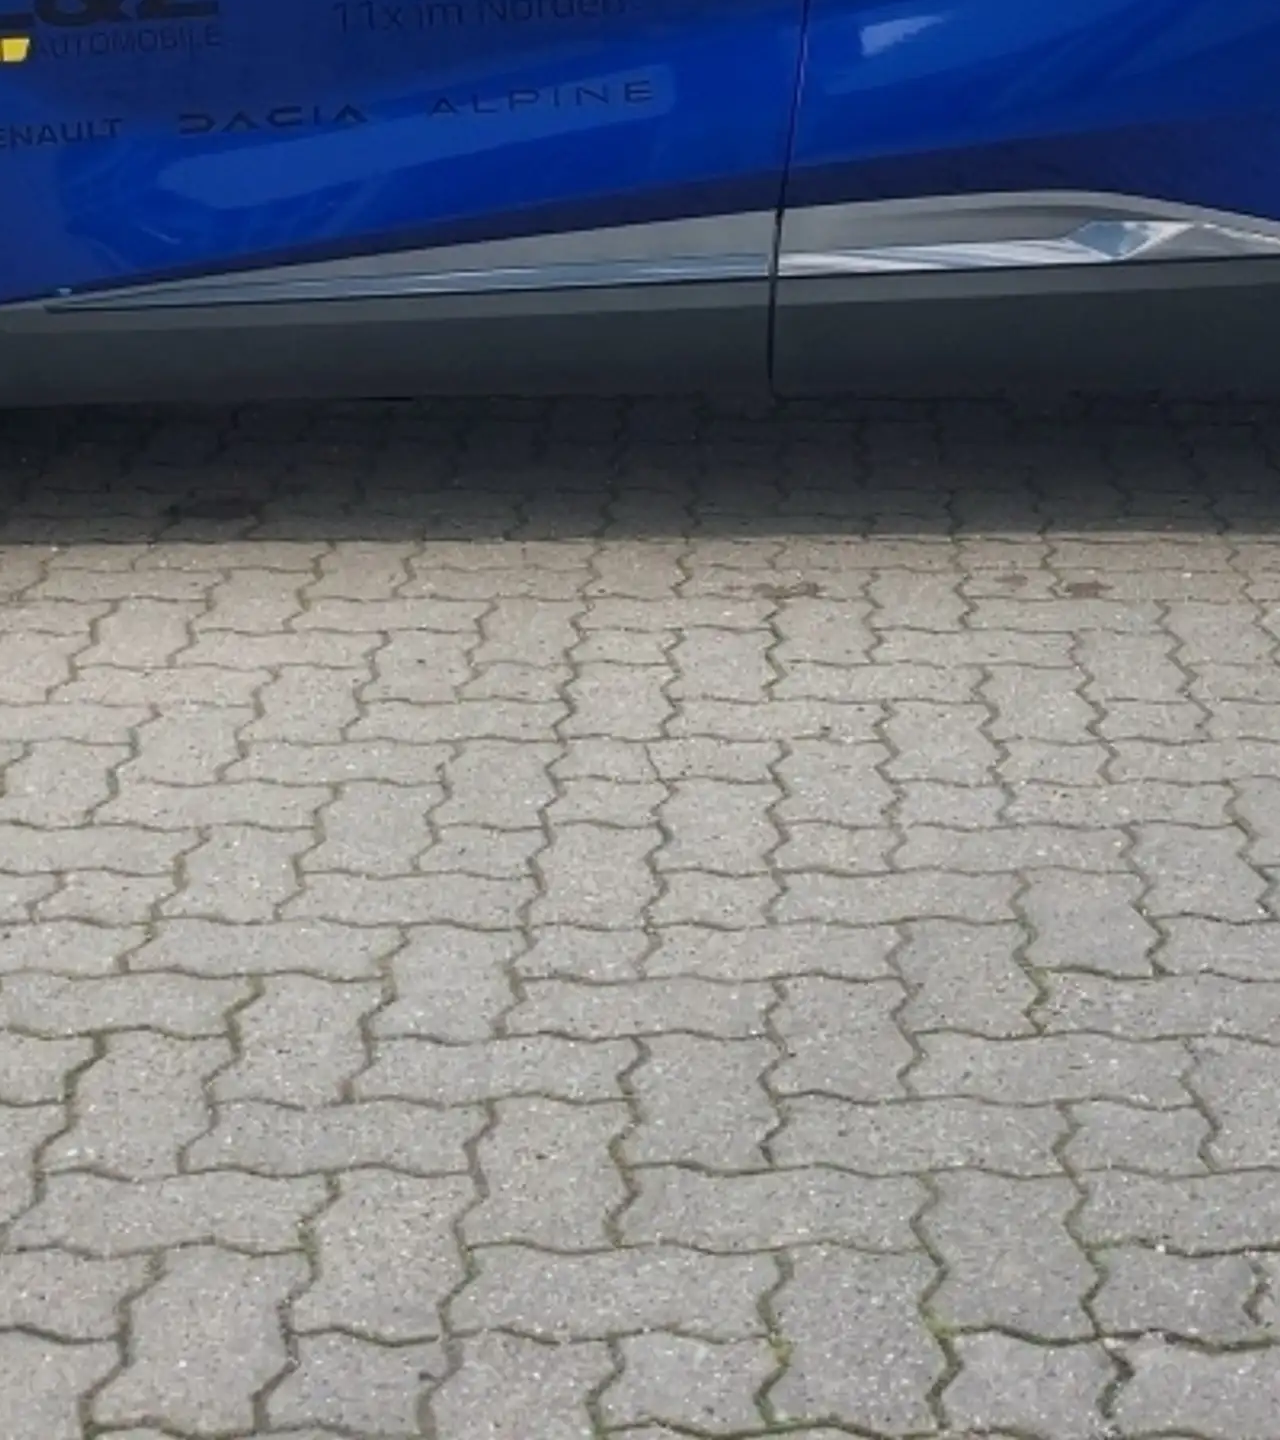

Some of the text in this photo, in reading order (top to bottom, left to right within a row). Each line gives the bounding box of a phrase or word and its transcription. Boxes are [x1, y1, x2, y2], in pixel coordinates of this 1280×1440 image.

[32, 22, 223, 61] AUTOMOBILE
[177, 103, 369, 136] DACIA
[431, 79, 655, 116] ALPINE
